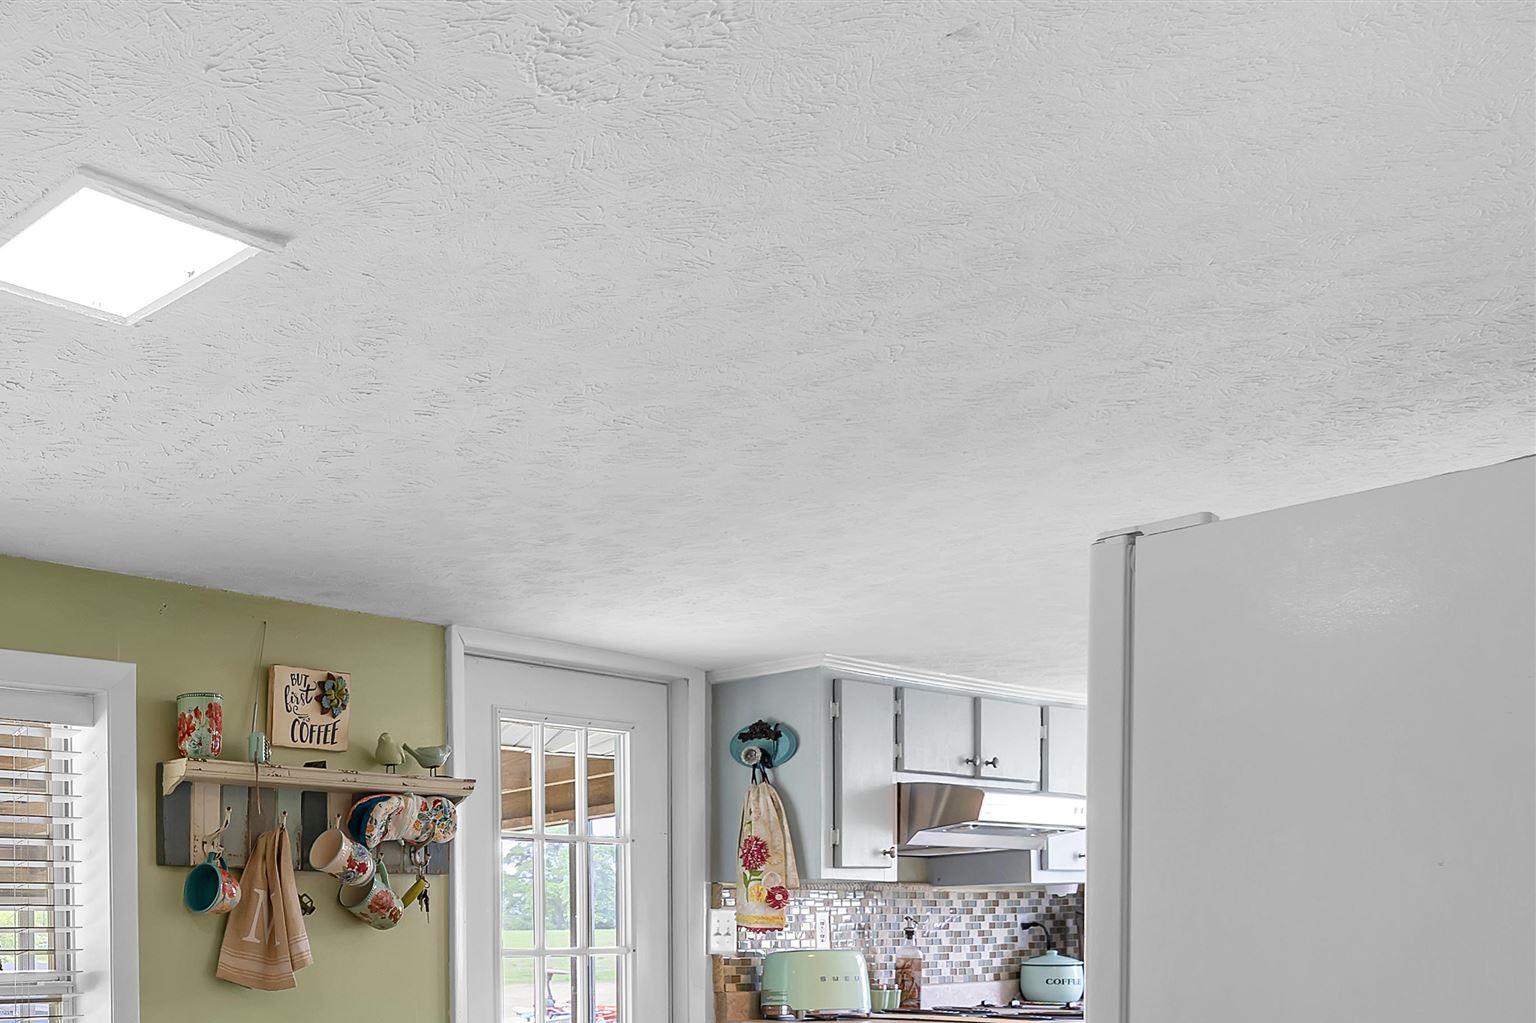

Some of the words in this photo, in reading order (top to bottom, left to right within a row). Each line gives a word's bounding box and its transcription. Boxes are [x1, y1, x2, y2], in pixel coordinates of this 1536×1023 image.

[290, 673, 310, 688] BUT
[284, 681, 318, 713] first
[290, 718, 341, 745] COFFEE
